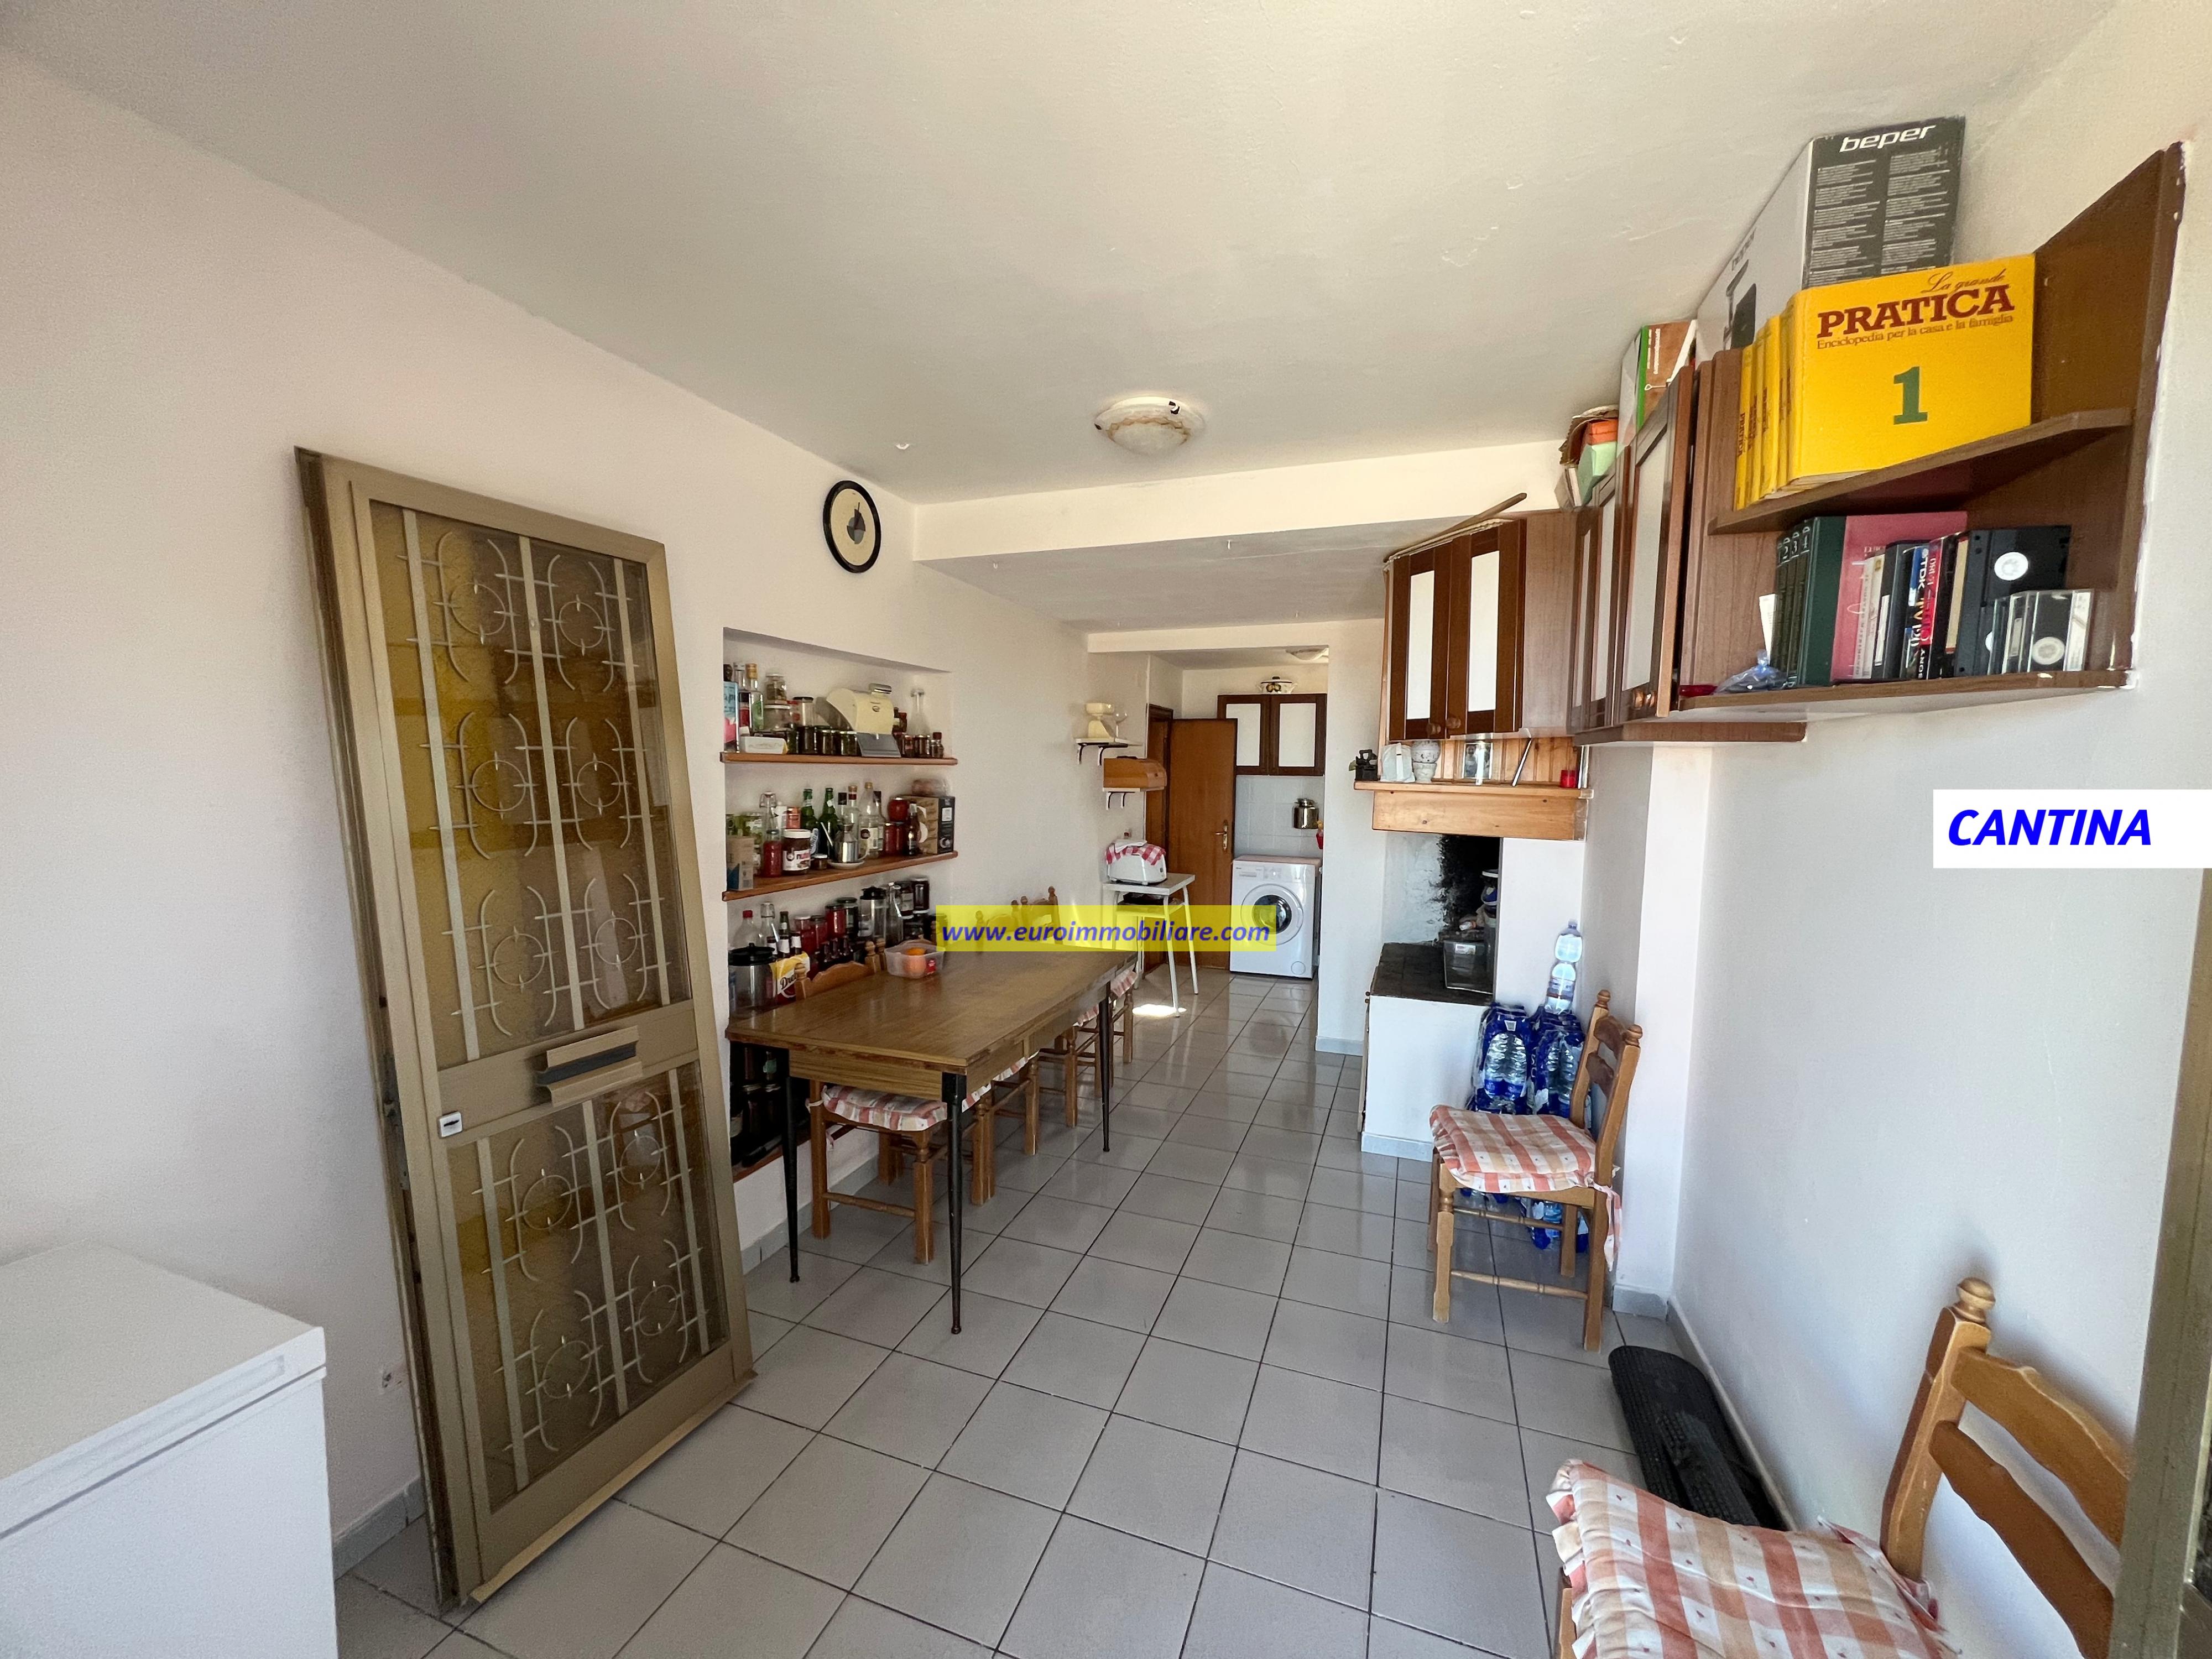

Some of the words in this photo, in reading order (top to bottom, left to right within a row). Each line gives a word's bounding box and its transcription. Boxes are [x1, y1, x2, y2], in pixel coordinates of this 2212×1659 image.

[1839, 124, 1936, 153] beper
[1921, 271, 1951, 294] La
[1817, 284, 2015, 338] PRATICA
[1817, 333, 1884, 350] Enciclopedia
[1887, 330, 1906, 342] per
[1907, 326, 1917, 336] la
[1919, 324, 1944, 335] casa
[1945, 322, 1954, 331] e
[1955, 319, 1965, 330] la
[1968, 314, 2013, 329] famiglia
[1892, 366, 1928, 425] 1
[1918, 561, 1927, 589] TDK
